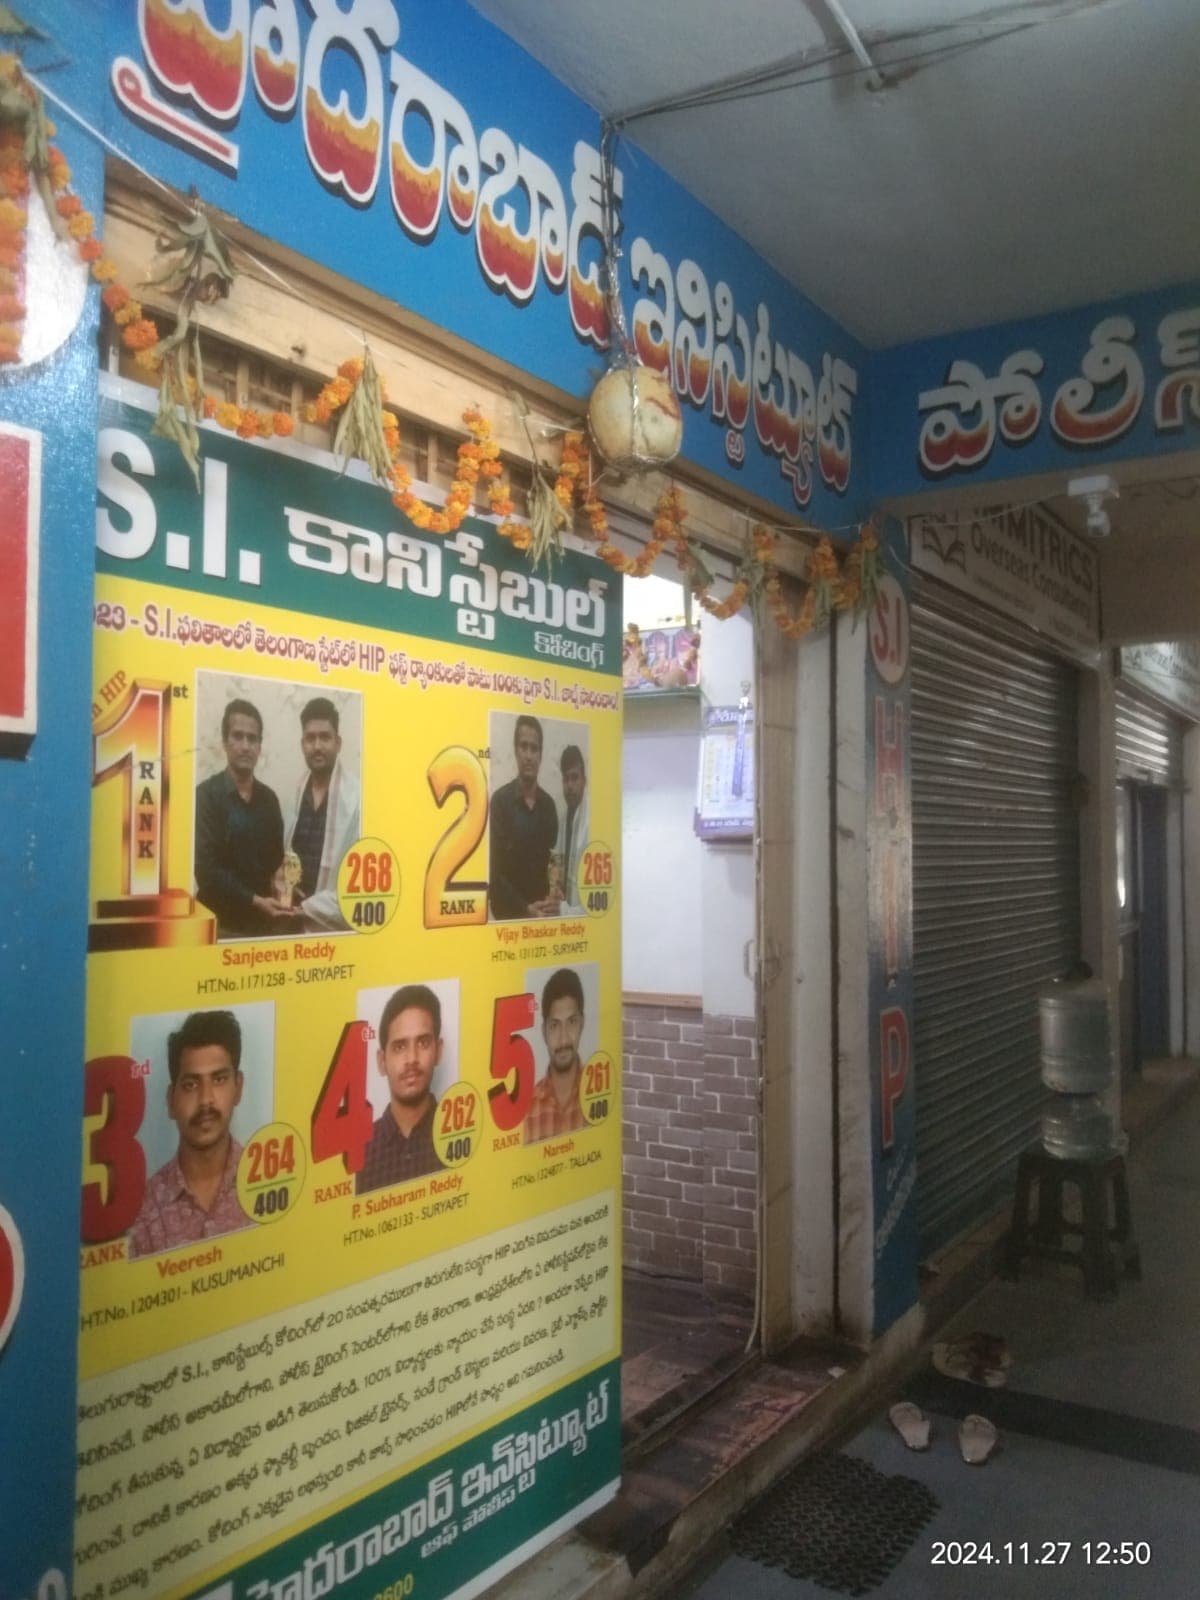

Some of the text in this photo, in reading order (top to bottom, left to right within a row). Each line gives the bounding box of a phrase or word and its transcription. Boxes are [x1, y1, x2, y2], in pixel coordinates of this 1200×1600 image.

[95, 428, 261, 587] S.I.
[358, 642, 386, 672] HIP
[346, 851, 393, 894] 268
[583, 852, 613, 886] 265
[351, 900, 386, 928] 400
[440, 898, 476, 916] RANK
[587, 891, 608, 912] 400
[496, 923, 586, 944] Vijay Bhaskar Reddy
[222, 942, 336, 974] Sanjeeva Reddy
[552, 941, 588, 956] SURYAPET
[295, 964, 355, 986] SURYAPET
[586, 1061, 611, 1096] 261
[441, 1093, 476, 1135] 262
[588, 1100, 608, 1121] 400
[445, 1137, 472, 1163] 400
[493, 1133, 520, 1152] RANK
[543, 1140, 575, 1160] Naresh
[246, 1135, 296, 1185] 264
[253, 1186, 289, 1217] 400
[314, 1180, 353, 1205] RANK
[352, 1174, 464, 1220] P. Subharam Reddy
[421, 1193, 470, 1220] SURYAPET
[157, 1246, 223, 1279] Veeresh
[493, 1242, 511, 1261] HIP
[191, 1252, 286, 1296] KUSUMANCHI
[362, 1365, 392, 1388] 100%
[594, 1264, 609, 1282] HIP
